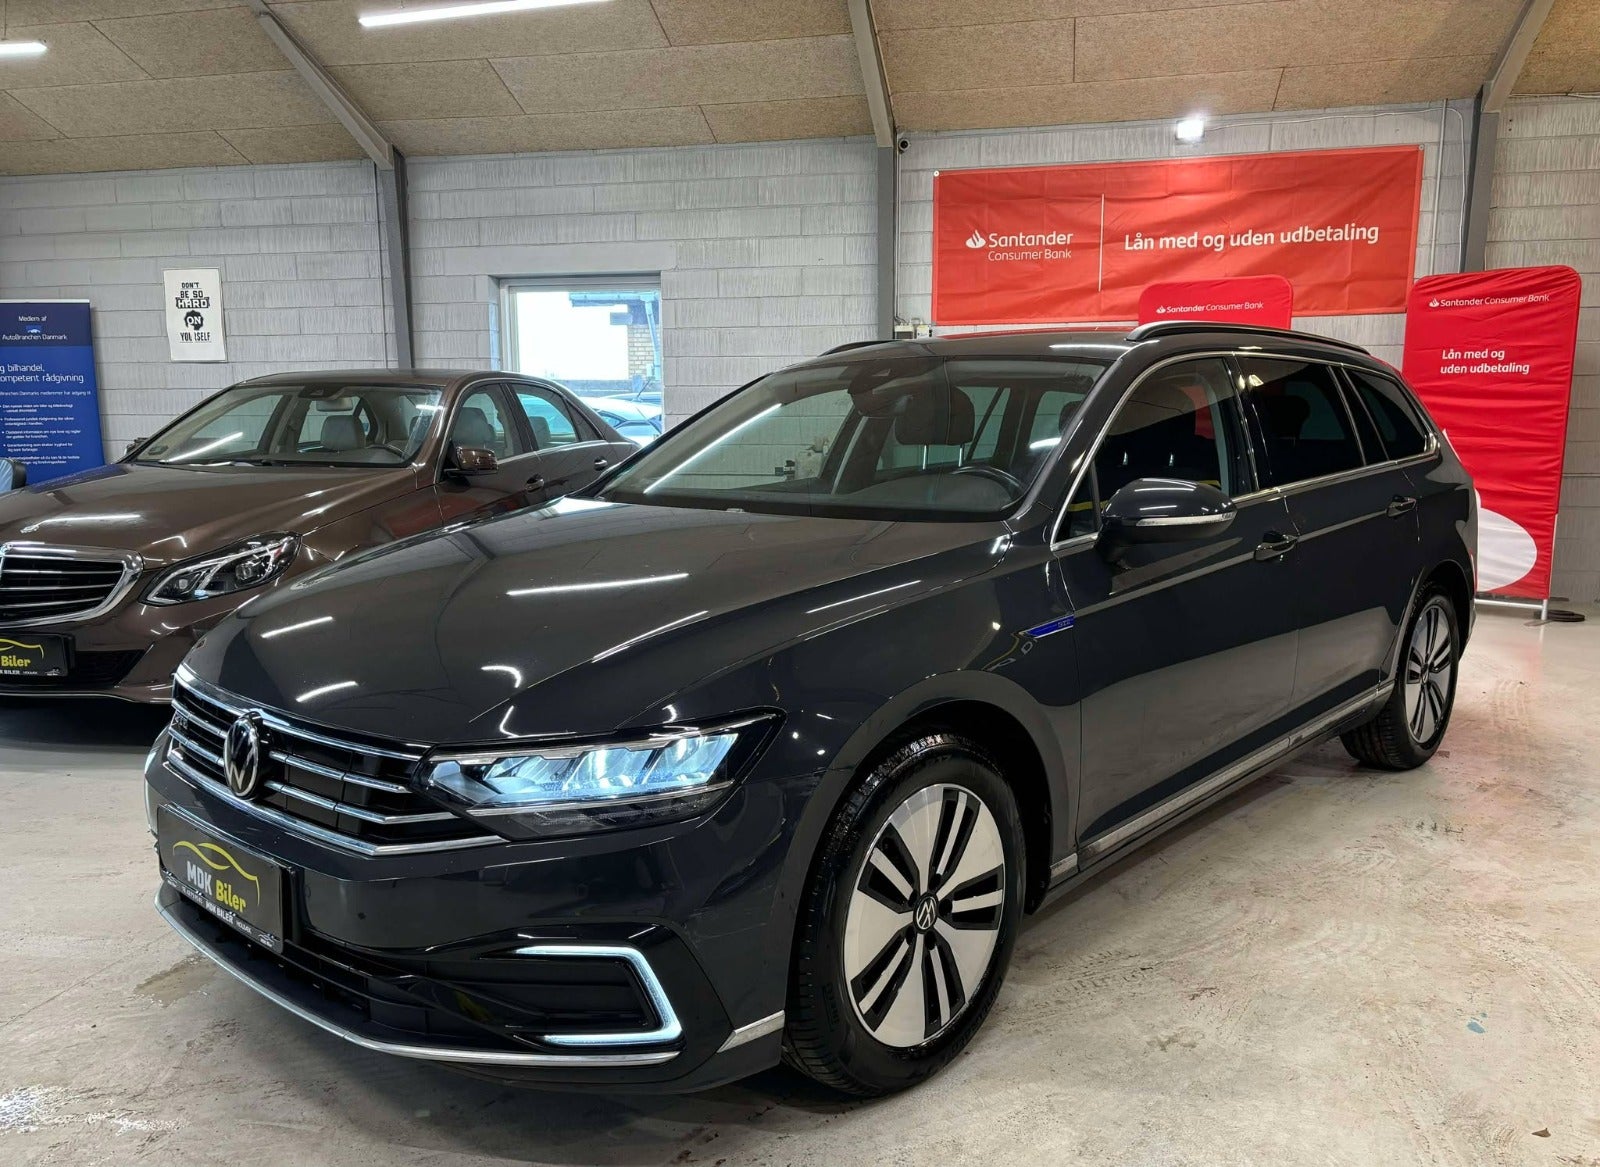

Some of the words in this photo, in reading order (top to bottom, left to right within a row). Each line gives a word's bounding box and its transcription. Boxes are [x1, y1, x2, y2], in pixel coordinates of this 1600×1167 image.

[988, 231, 1074, 248] Santander
[1124, 232, 1154, 250] Lån
[1159, 231, 1198, 249] med
[1202, 233, 1225, 252] og
[1229, 229, 1275, 247] uden
[1280, 222, 1379, 244] udbetaling
[988, 250, 1043, 262] Consumer
[1044, 248, 1072, 260] Bank
[180, 290, 189, 299] BE
[192, 290, 204, 299] SO
[1440, 297, 1484, 307] Santander
[1484, 295, 1528, 305] Consumer
[1528, 293, 1550, 303] Bank
[177, 298, 209, 309] HARD
[1166, 304, 1205, 313] Santander
[1205, 302, 1244, 311] Consumer
[1244, 300, 1264, 310] Bank
[186, 315, 202, 325] ON
[1441, 348, 1462, 360] Lån
[1463, 348, 1489, 359] med
[1490, 350, 1506, 361] og
[1440, 363, 1467, 374] uden
[1469, 362, 1530, 375] udbetaling
[42, 373, 84, 384] rådgivning
[0, 655, 31, 667] Biler
[186, 860, 213, 896] MDK
[215, 879, 247, 913] Biler
[216, 907, 234, 925] BILER
